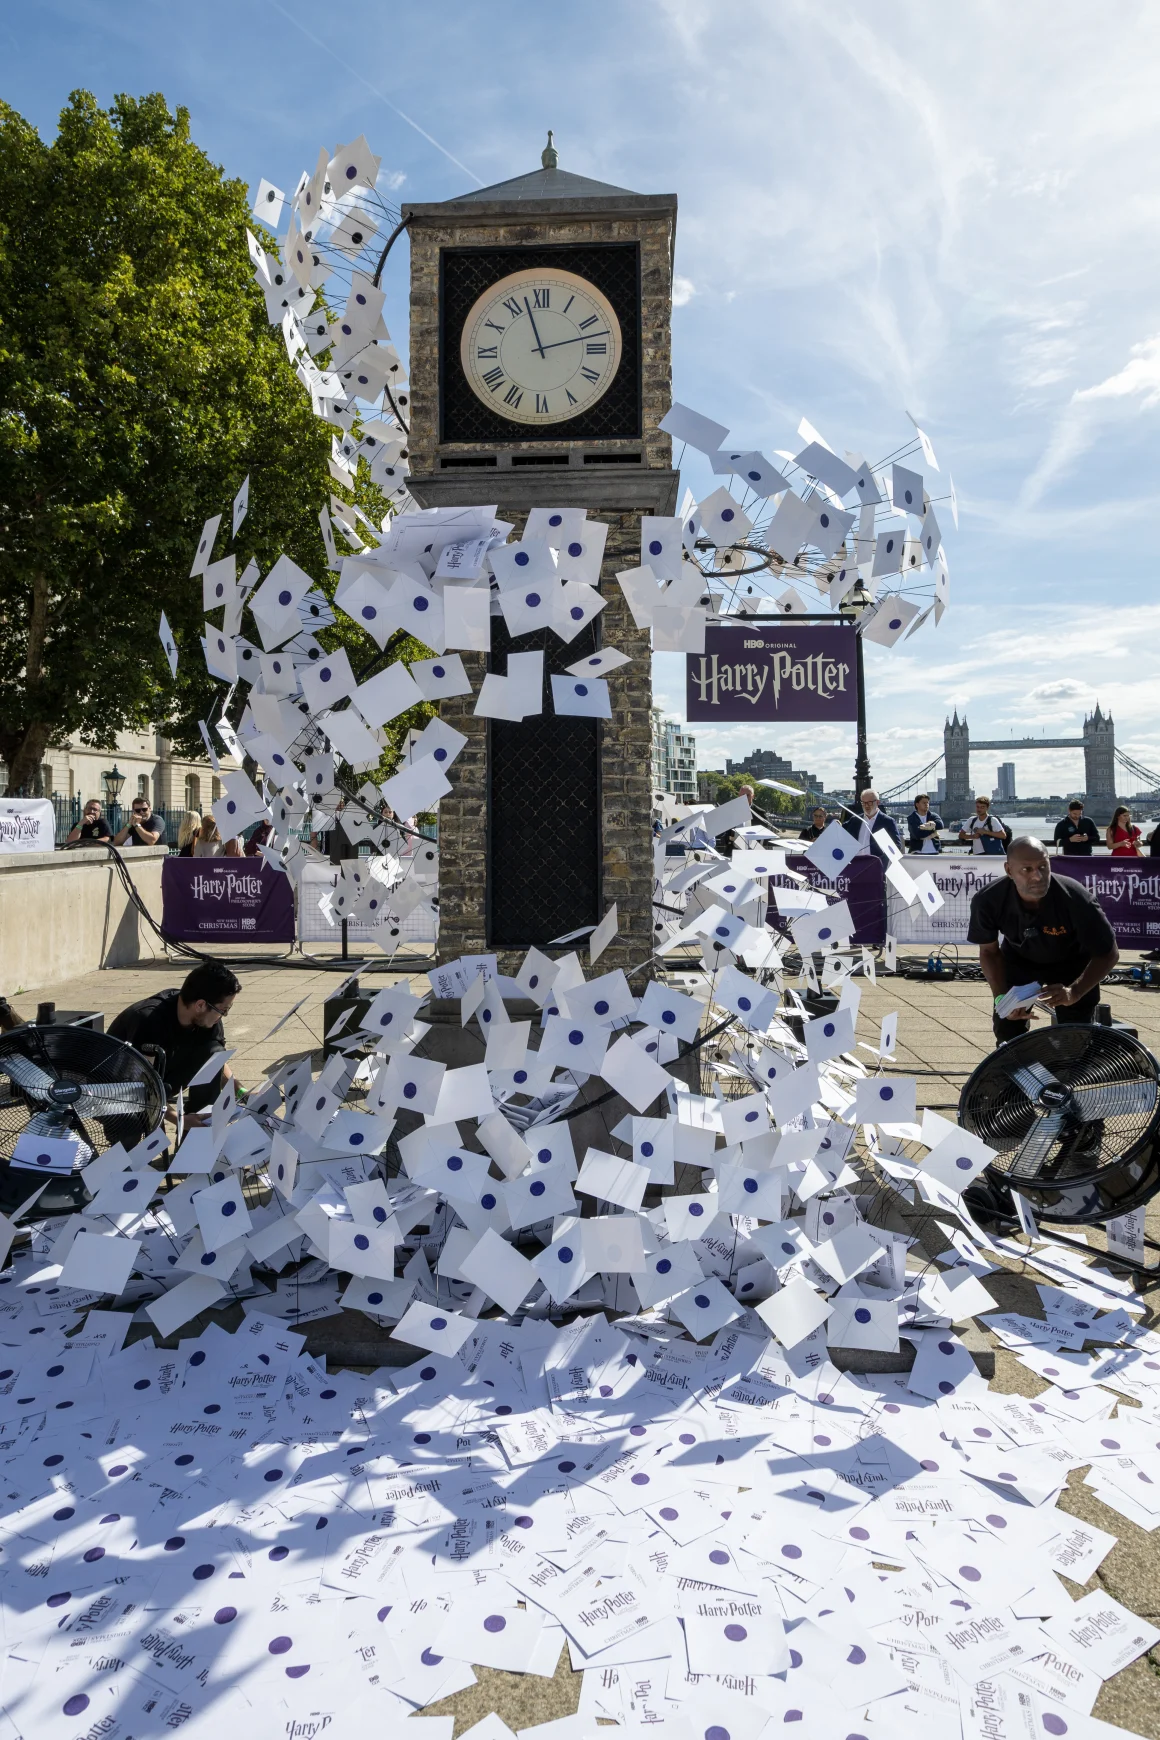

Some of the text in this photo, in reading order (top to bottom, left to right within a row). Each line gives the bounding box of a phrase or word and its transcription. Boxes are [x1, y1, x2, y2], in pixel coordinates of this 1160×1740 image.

[503, 296, 522, 319] XI
[533, 288, 550, 308] XII
[564, 296, 575, 313] I
[484, 318, 505, 335] X
[579, 314, 599, 330] II
[478, 346, 498, 359] IX
[586, 342, 606, 355] III
[482, 366, 506, 393] VIII
[580, 366, 600, 386] IV
[503, 384, 525, 409] VII
[536, 394, 550, 414] VI
[565, 388, 578, 406] V
[744, 640, 765, 648] HBO
[691, 650, 850, 710] Harry Potter
[14, 815, 40, 840] Potter
[190, 874, 262, 903] Harry Potter
[964, 872, 998, 902] Pott
[1084, 874, 1160, 906] Harry Pott
[1050, 1326, 1075, 1338] Potter
[500, 1341, 514, 1358] Har
[228, 1374, 278, 1388] Harry Potter
[644, 1370, 668, 1386] Potter
[730, 1390, 757, 1406] Potter
[170, 1423, 222, 1436] Harry Potter
[386, 1480, 442, 1501] Harry Potter
[896, 1500, 954, 1514] Harry Potter
[450, 1518, 470, 1562] Harry Potter
[1056, 1528, 1093, 1566] Harry Potter
[341, 1534, 382, 1579] Harry Potter
[528, 1566, 557, 1588] Harry
[80, 1596, 112, 1623] Potter
[578, 1590, 636, 1628] Harry Potter
[698, 1602, 762, 1617] Harry Potter
[635, 1616, 648, 1626] HBO
[916, 1611, 944, 1630] Pott
[1068, 1610, 1122, 1648] Harry Potter
[91, 1631, 132, 1642] CHRISTMAS
[604, 1625, 636, 1644] CHRISTMAS
[945, 1616, 1004, 1650] Harry Potter
[140, 1633, 197, 1670] Harry Potter
[1008, 1645, 1022, 1654] HBO
[979, 1654, 1010, 1670] CHRISTMAS
[1044, 1652, 1084, 1683] Potter
[722, 1674, 758, 1696] Harry
[1050, 1686, 1066, 1698] HBO
[974, 1680, 1006, 1740] Harry Potter
